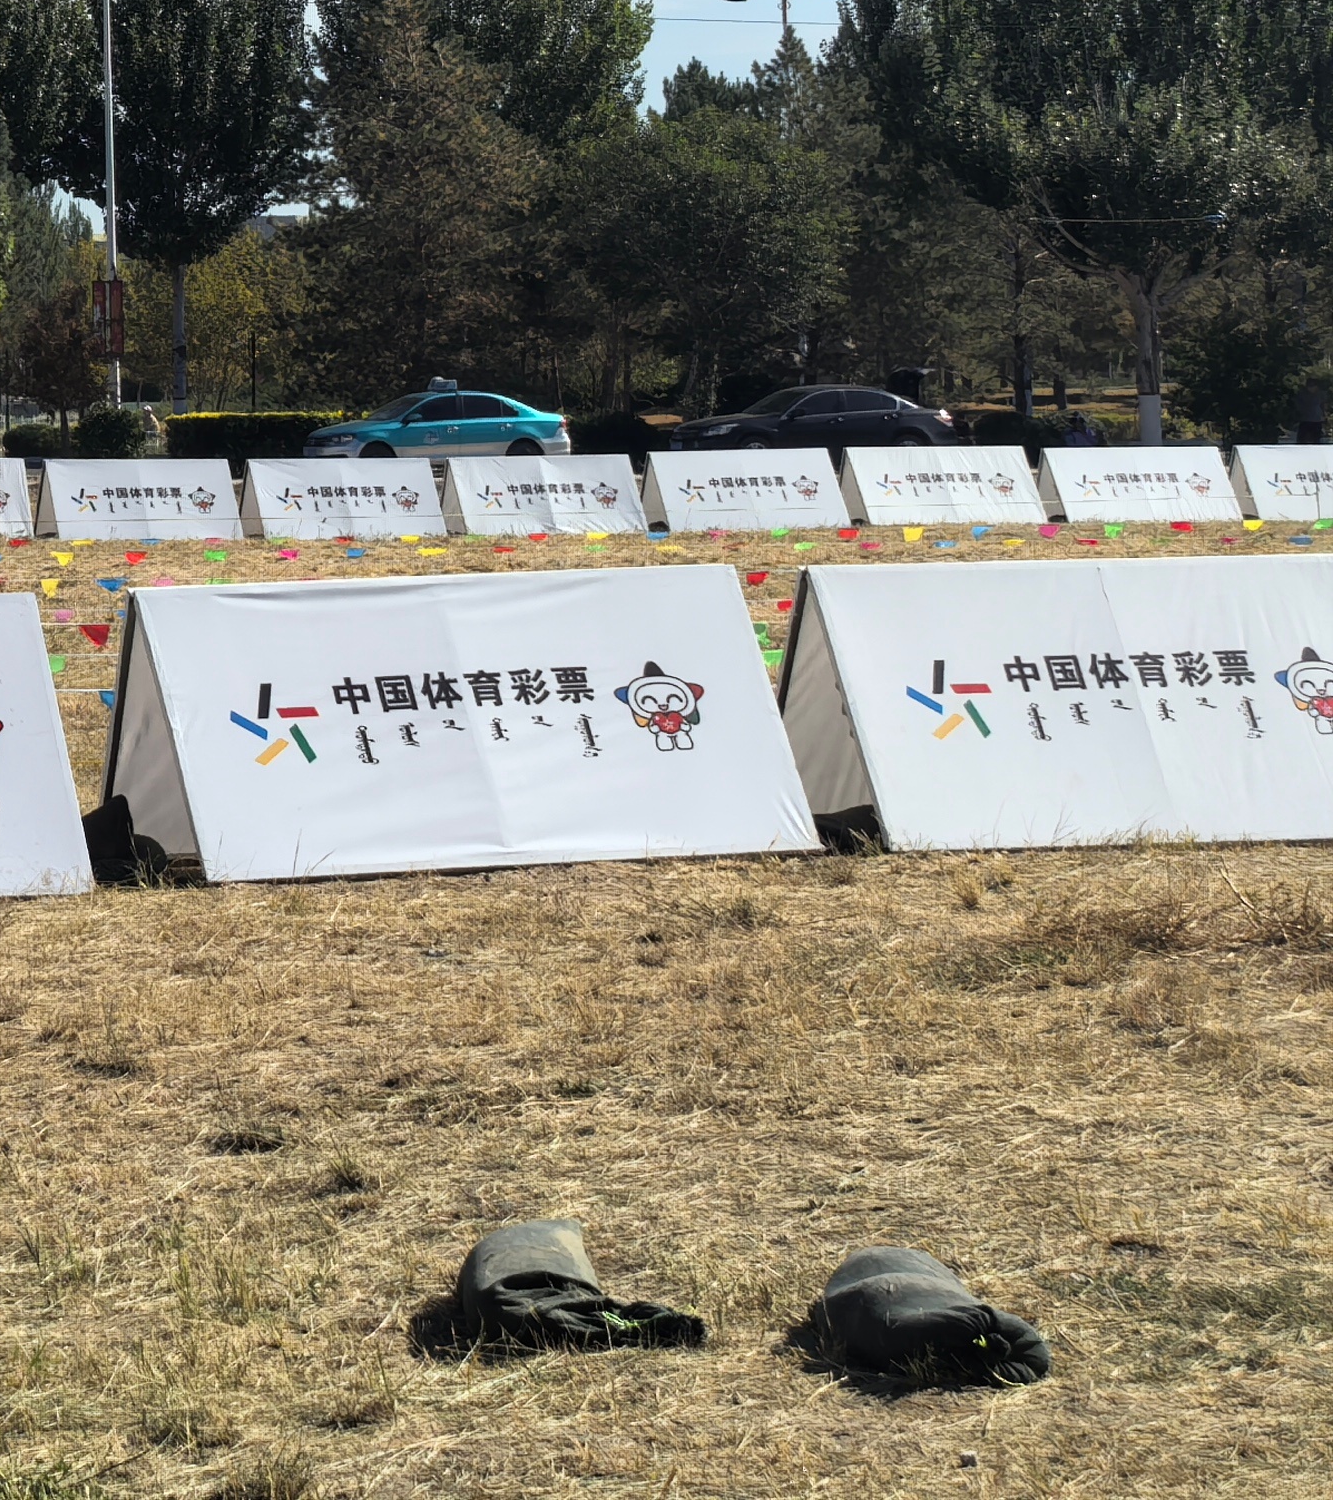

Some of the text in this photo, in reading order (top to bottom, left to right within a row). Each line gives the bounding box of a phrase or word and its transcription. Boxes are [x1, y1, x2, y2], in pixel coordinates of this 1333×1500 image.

[708, 476, 786, 488] 中国体育彩票
[905, 473, 982, 483] 中国体育彩票
[1104, 473, 1179, 484] 中国体育彩票
[102, 487, 182, 499] 中国体育彩票
[307, 486, 386, 498] 中国体育彩票
[507, 482, 585, 496] 中国体育彩票
[1003, 650, 1256, 692] 中国体育彩票
[332, 667, 595, 714] 中国体育彩票
